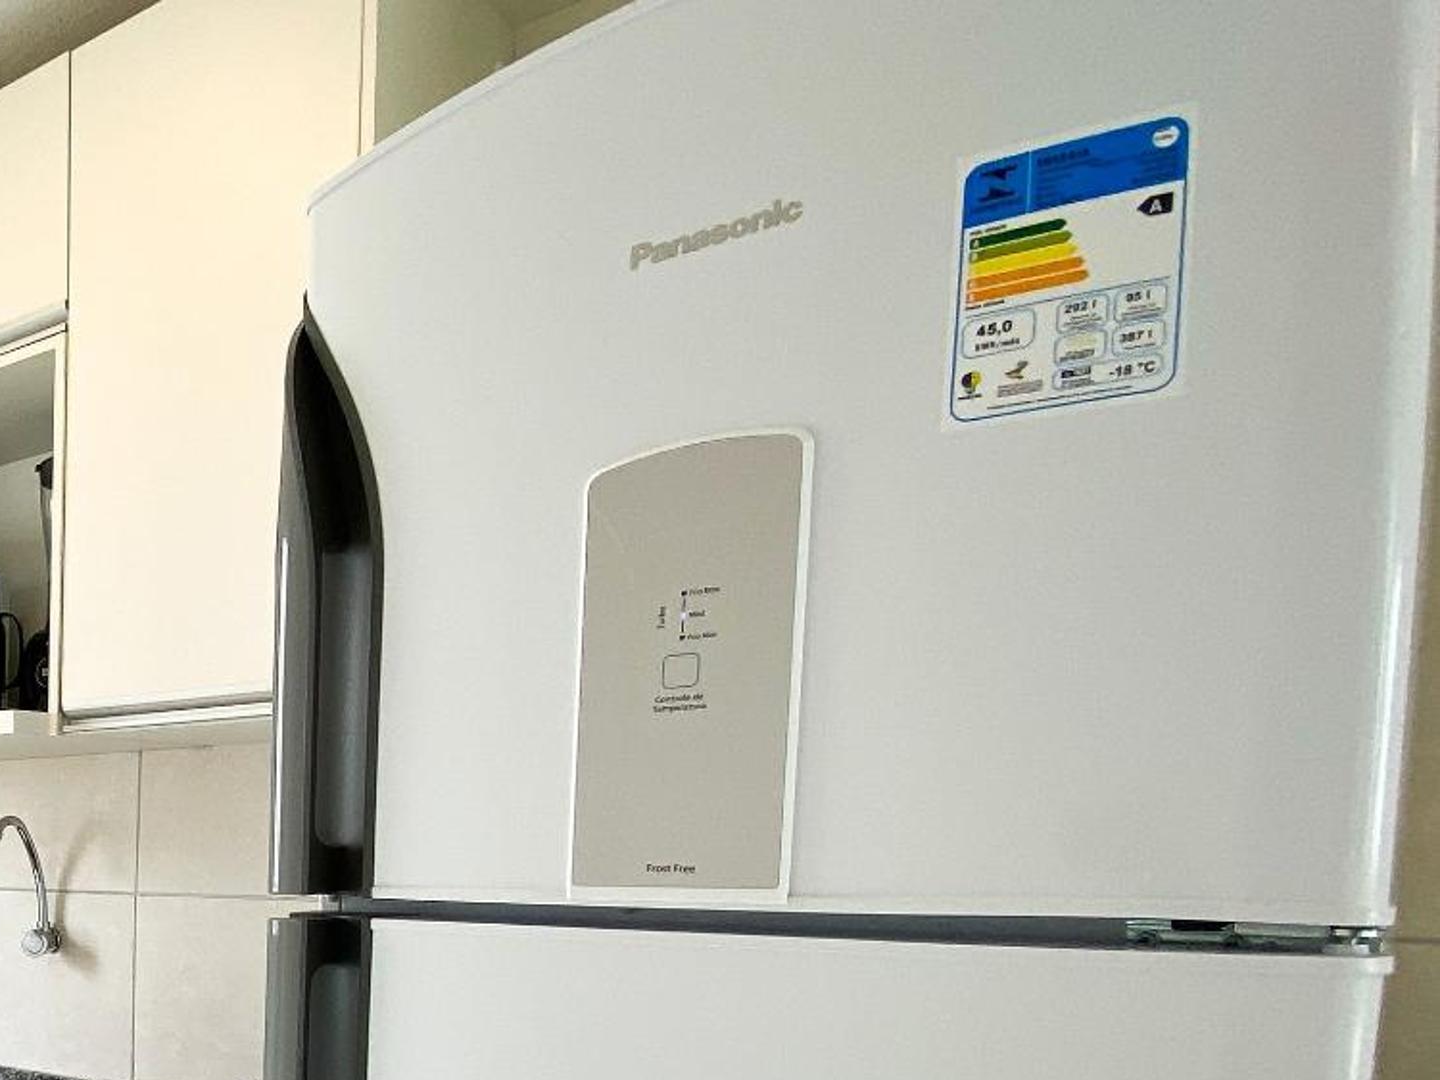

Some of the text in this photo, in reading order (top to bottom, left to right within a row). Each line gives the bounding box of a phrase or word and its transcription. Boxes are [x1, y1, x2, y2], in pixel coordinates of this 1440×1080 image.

[1149, 198, 1163, 213] A
[630, 199, 803, 270] Panasonic
[976, 319, 1013, 337] 45,0
[646, 863, 696, 873] Frost Free
